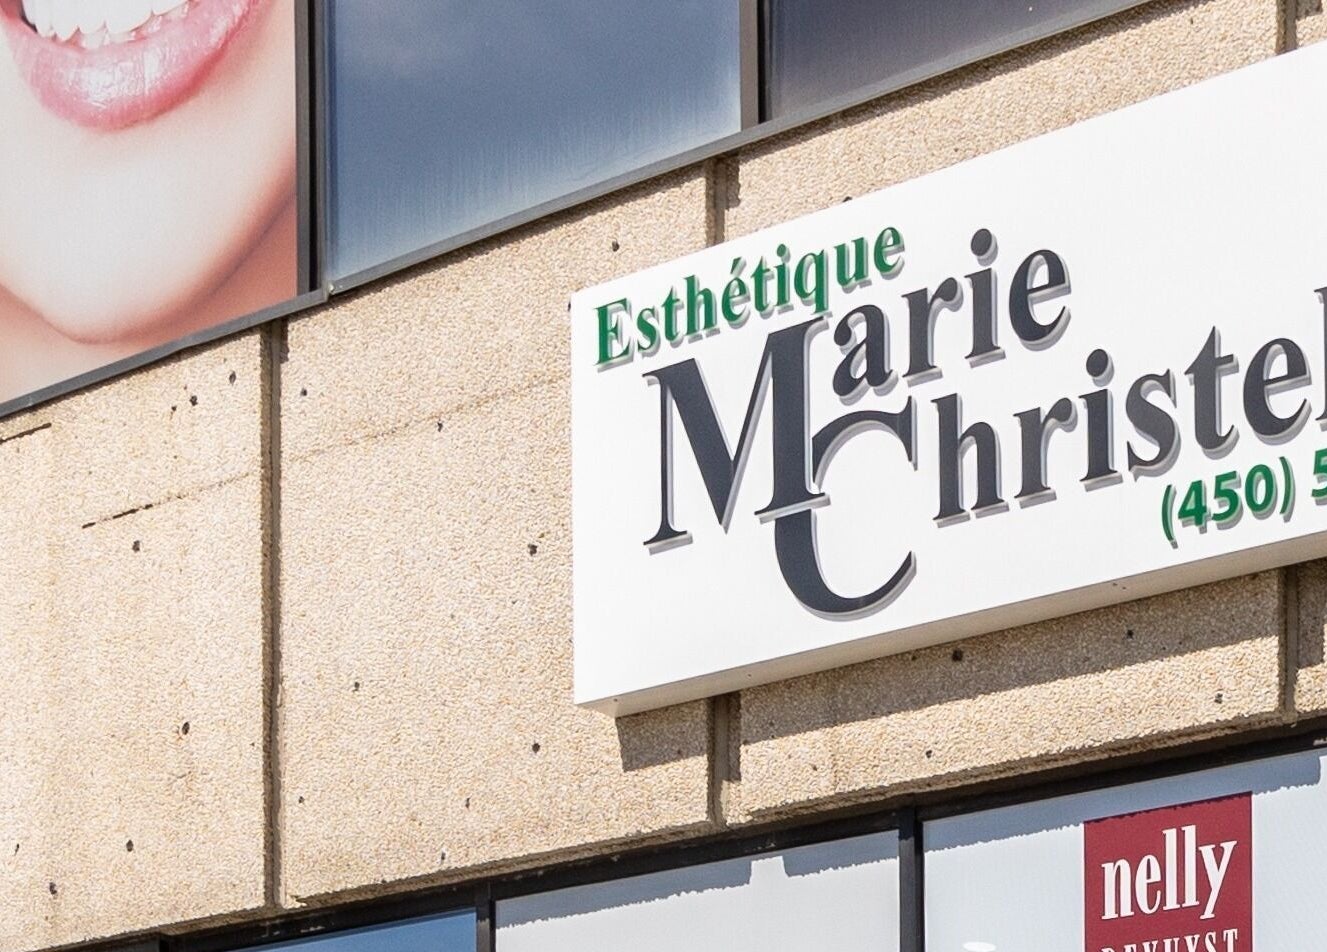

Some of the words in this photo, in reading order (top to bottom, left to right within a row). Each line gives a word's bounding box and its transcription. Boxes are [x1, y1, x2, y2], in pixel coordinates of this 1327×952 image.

[594, 226, 905, 368] Esthétique
[642, 228, 1072, 550] Marie
[1161, 455, 1293, 548] (450)
[1101, 824, 1238, 920] nelly
